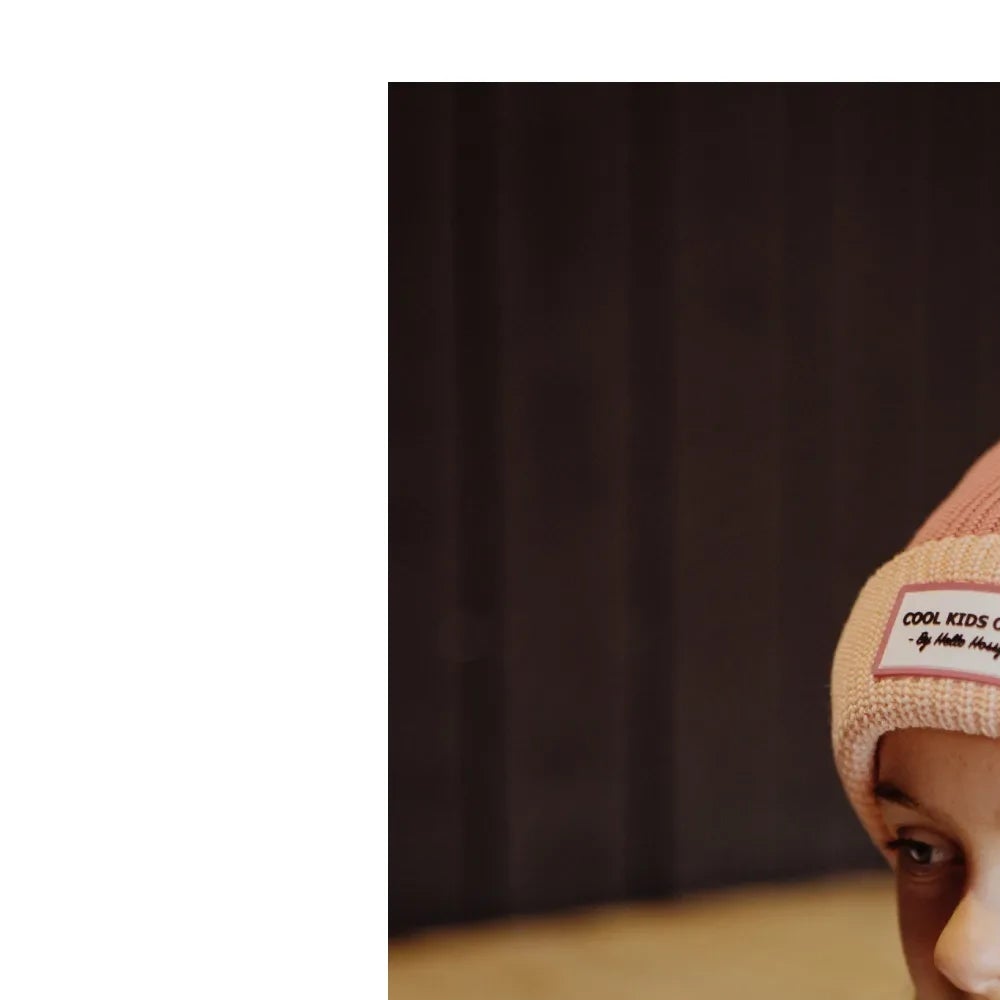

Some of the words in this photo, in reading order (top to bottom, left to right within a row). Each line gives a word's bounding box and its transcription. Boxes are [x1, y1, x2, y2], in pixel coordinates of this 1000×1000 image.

[902, 611, 941, 626] COOL
[945, 612, 989, 629] KIDS
[916, 631, 932, 652] By
[933, 632, 966, 648] Hello
